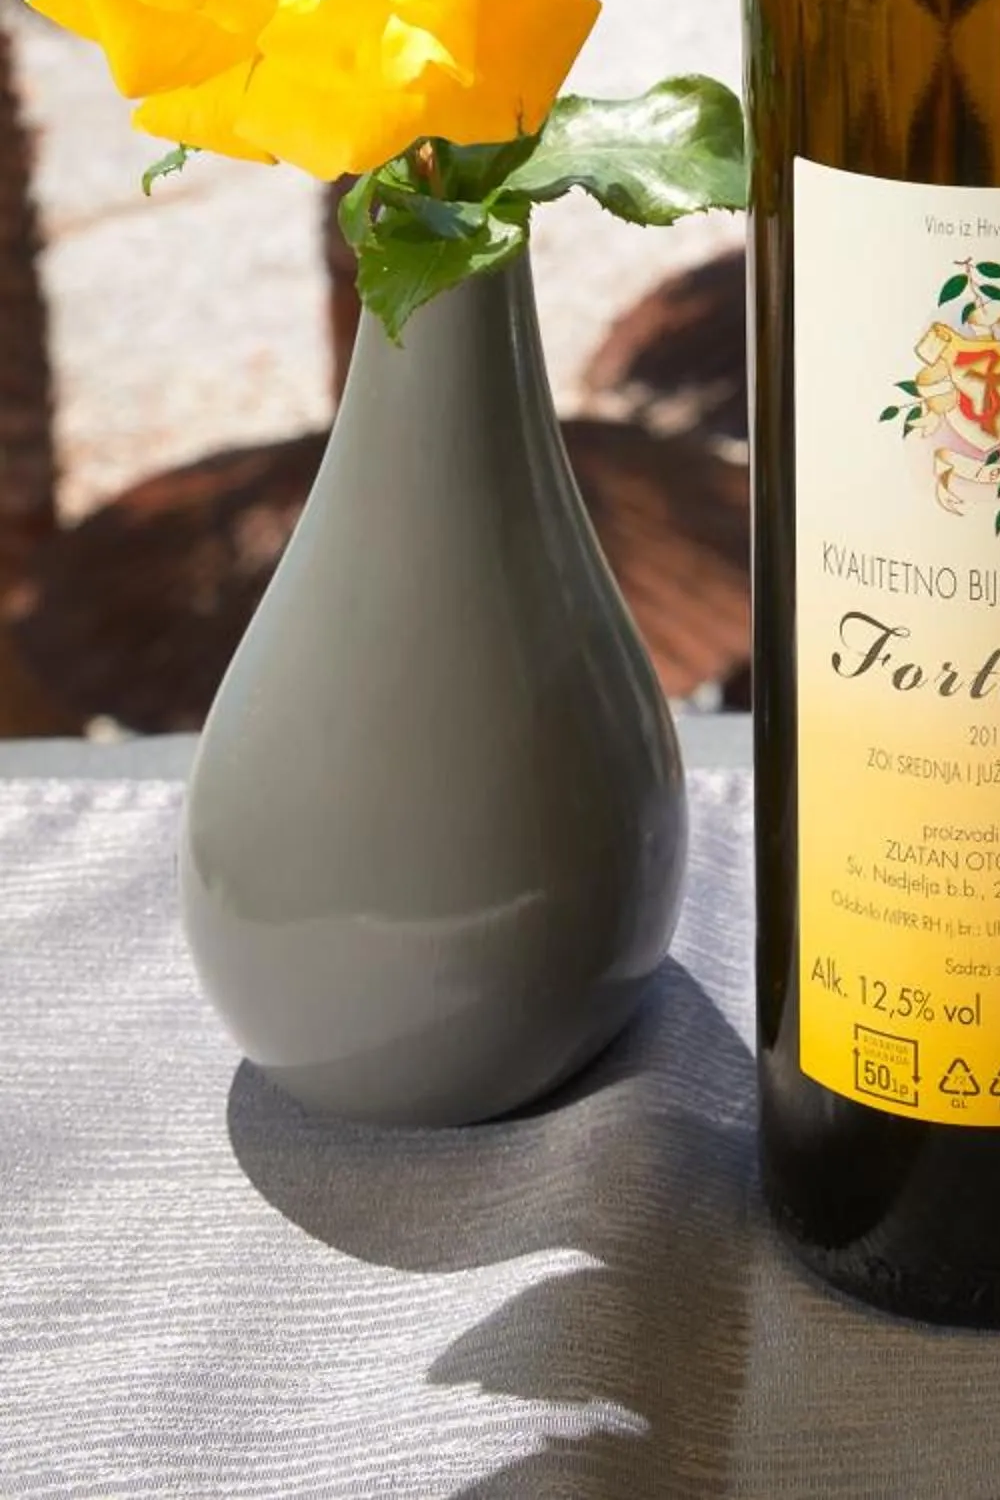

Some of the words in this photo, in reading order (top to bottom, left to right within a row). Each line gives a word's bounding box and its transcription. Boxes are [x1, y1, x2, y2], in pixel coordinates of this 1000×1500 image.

[924, 215, 954, 236] Vino
[959, 219, 971, 237] iz
[822, 541, 957, 599] KVALITETNO
[898, 755, 961, 785] SREDNJA
[923, 824, 999, 843] proizvodi
[885, 839, 959, 870] ZLATAN
[873, 864, 940, 898] Nedjelja
[811, 956, 848, 998] Alk.
[859, 975, 935, 1022] 12,5%
[944, 992, 981, 1026] vol
